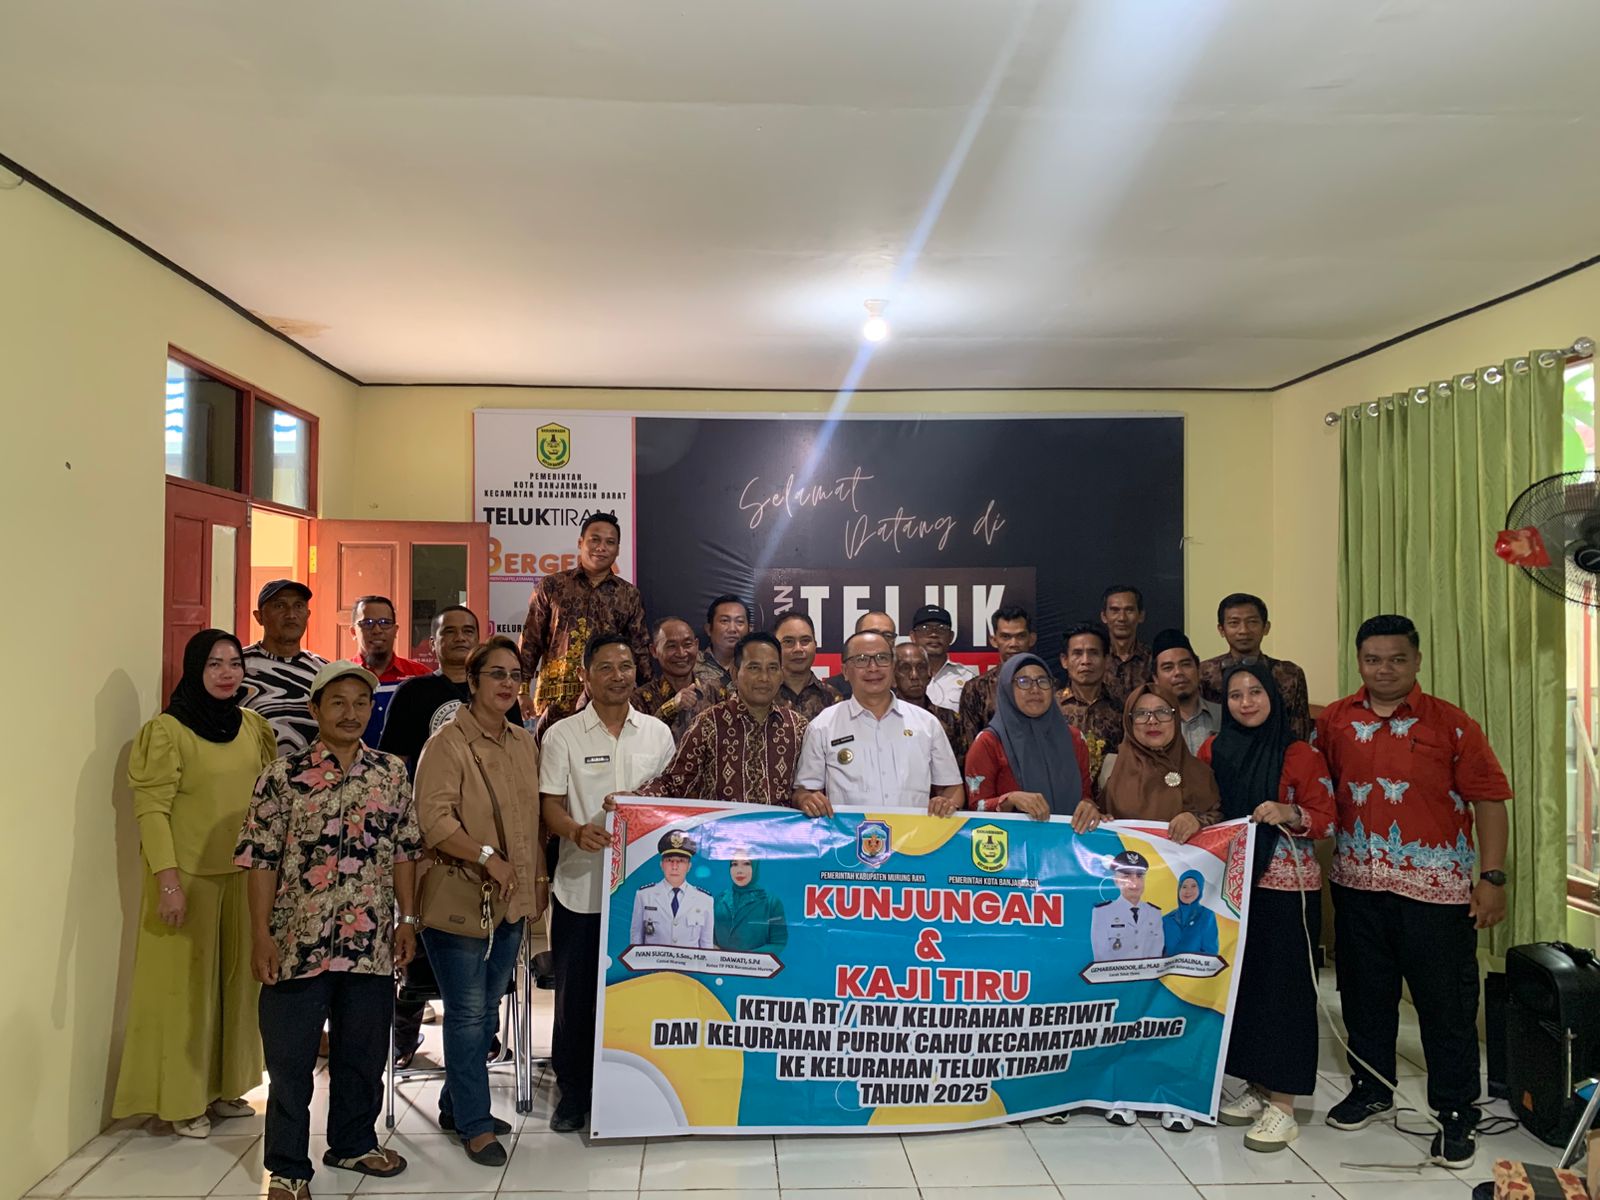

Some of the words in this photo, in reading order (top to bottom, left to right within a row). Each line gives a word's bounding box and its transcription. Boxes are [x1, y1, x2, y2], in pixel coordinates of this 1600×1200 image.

[484, 490, 534, 498] KECAMATAN
[538, 491, 597, 499] BANJARMASIN
[601, 492, 626, 500] BARAT
[538, 482, 598, 490] BANJARMASIN
[739, 466, 874, 529] Selamat
[845, 506, 956, 560] Datang
[972, 499, 1006, 546] di
[800, 584, 1006, 649] TELUK
[820, 872, 854, 880] PEMERINTAH
[856, 872, 887, 881] KABUPATEN
[888, 874, 910, 882] MURUNG
[912, 874, 925, 882] RAYA
[948, 876, 983, 884] PEMERINTAH
[984, 877, 998, 886] KOTA
[999, 878, 1039, 888] BANJARMASIN
[805, 886, 1063, 926] KUNJUNGAN
[916, 929, 944, 960] &
[836, 966, 930, 1000] KAJI
[938, 970, 1030, 1001] TIRU
[739, 998, 807, 1023] KETUA
[812, 1001, 840, 1025] RT
[860, 1004, 900, 1026] RW
[902, 1006, 1024, 1028] KELURAHAN
[1029, 1002, 1116, 1026] BERIWIT
[654, 1022, 698, 1045] DAN
[708, 1024, 832, 1050] KELURAHAN
[837, 1030, 910, 1053] PURUK
[914, 1032, 972, 1054] CAHU
[977, 1028, 1098, 1054] KECAMATAN
[1100, 1019, 1183, 1044] MURUNG
[779, 1055, 805, 1077] KE
[810, 1056, 932, 1078] KELURAHAN
[938, 1056, 1000, 1078] TELUK
[1004, 1053, 1069, 1077] TIRAM
[859, 1083, 930, 1104] TAHUN
[933, 1082, 989, 1103] 2025
